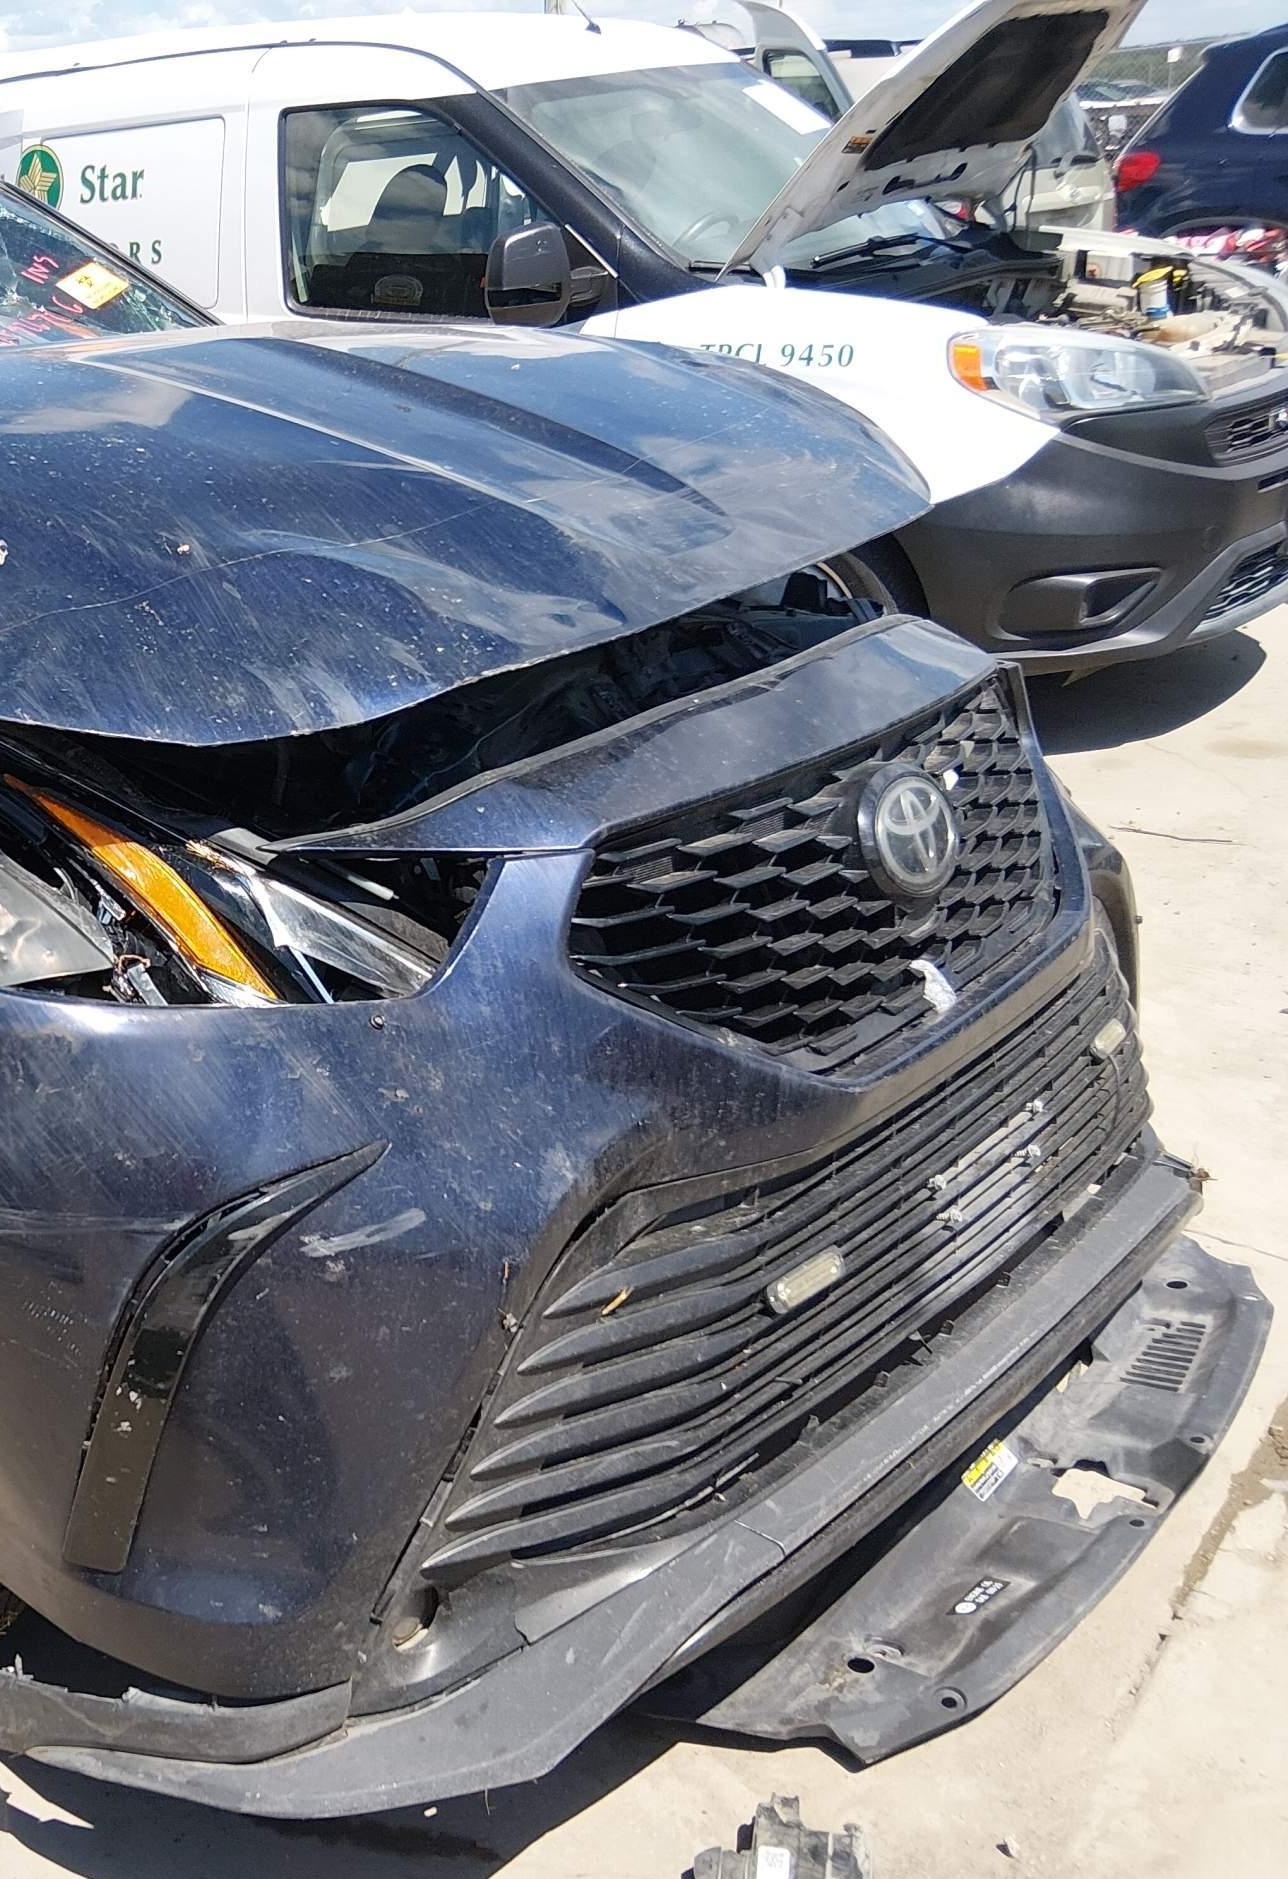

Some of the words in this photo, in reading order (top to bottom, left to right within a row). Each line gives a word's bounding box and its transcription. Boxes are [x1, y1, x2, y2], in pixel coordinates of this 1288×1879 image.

[79, 164, 145, 204] Star
[109, 239, 162, 265] RS
[780, 343, 855, 367] 9450
